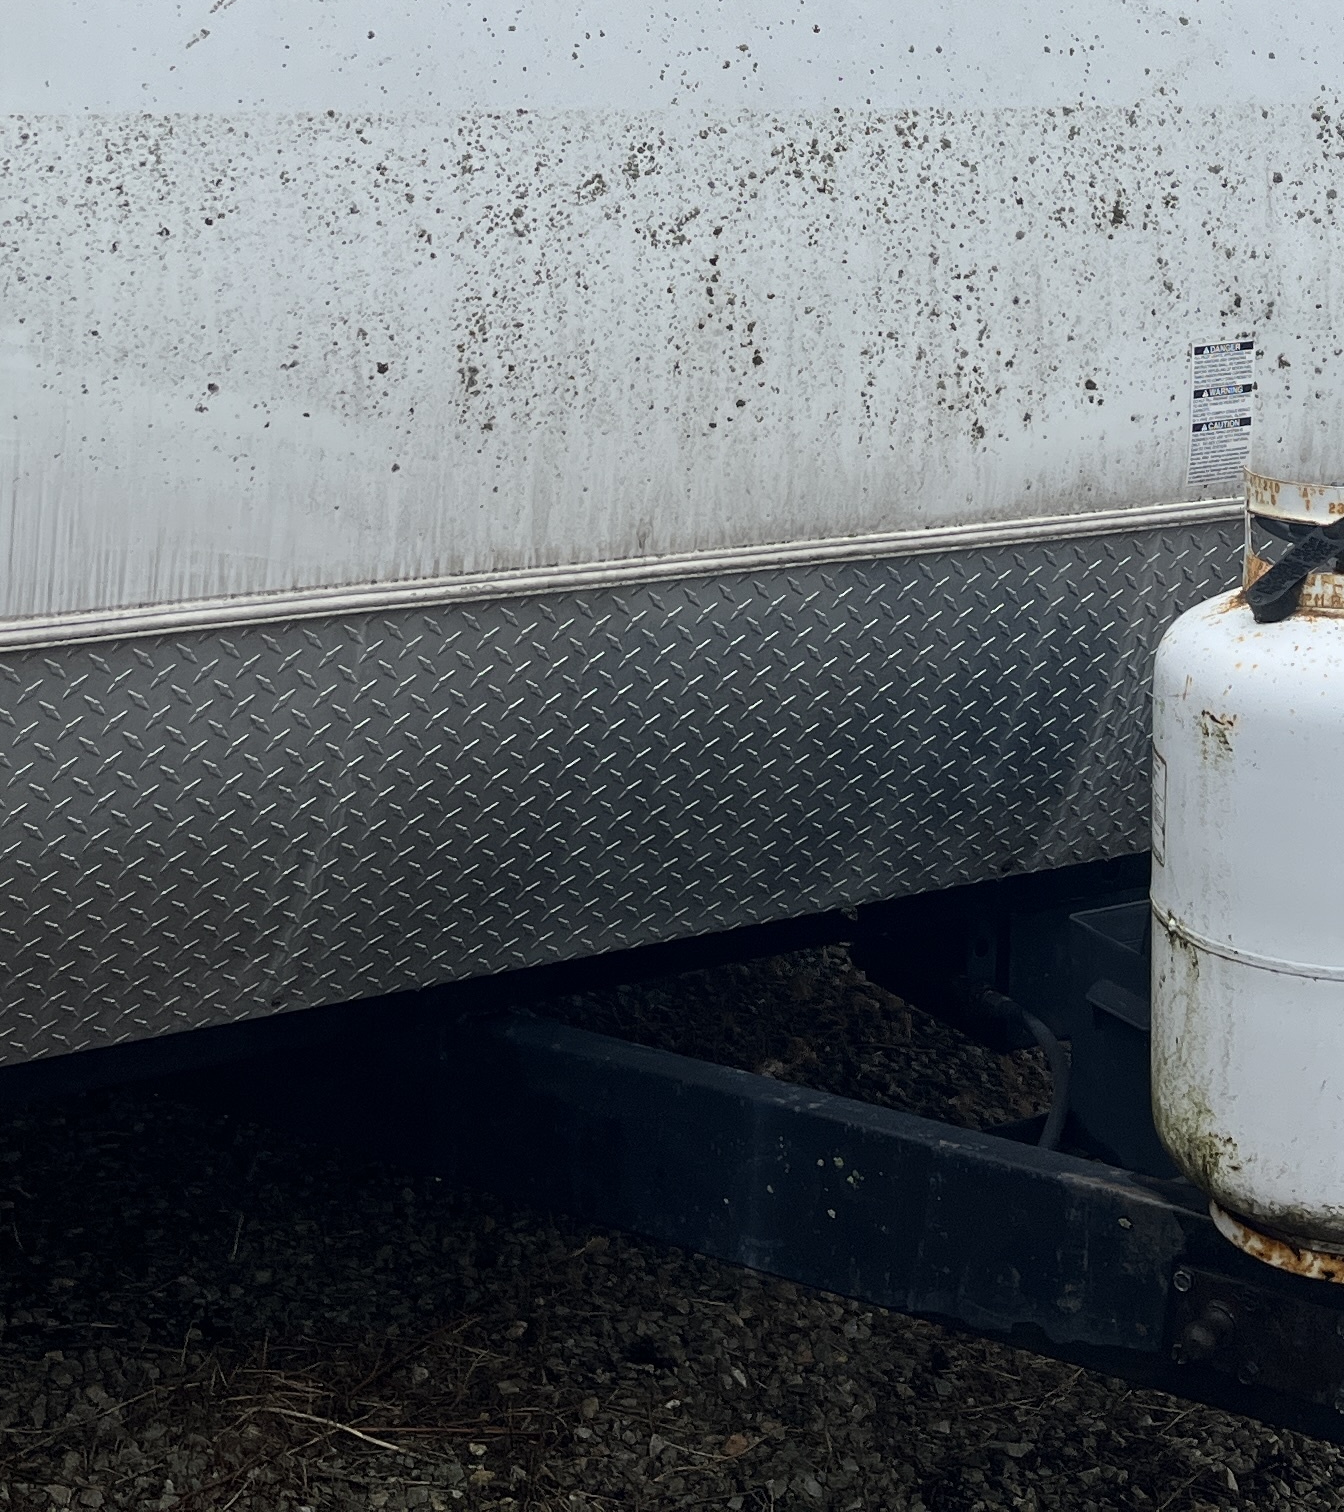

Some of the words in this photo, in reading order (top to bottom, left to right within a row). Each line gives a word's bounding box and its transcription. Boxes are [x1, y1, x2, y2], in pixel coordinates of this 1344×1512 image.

[1209, 343, 1241, 354] DANGER
[1208, 385, 1244, 396] WARNING
[1207, 418, 1241, 430] CAUTION
